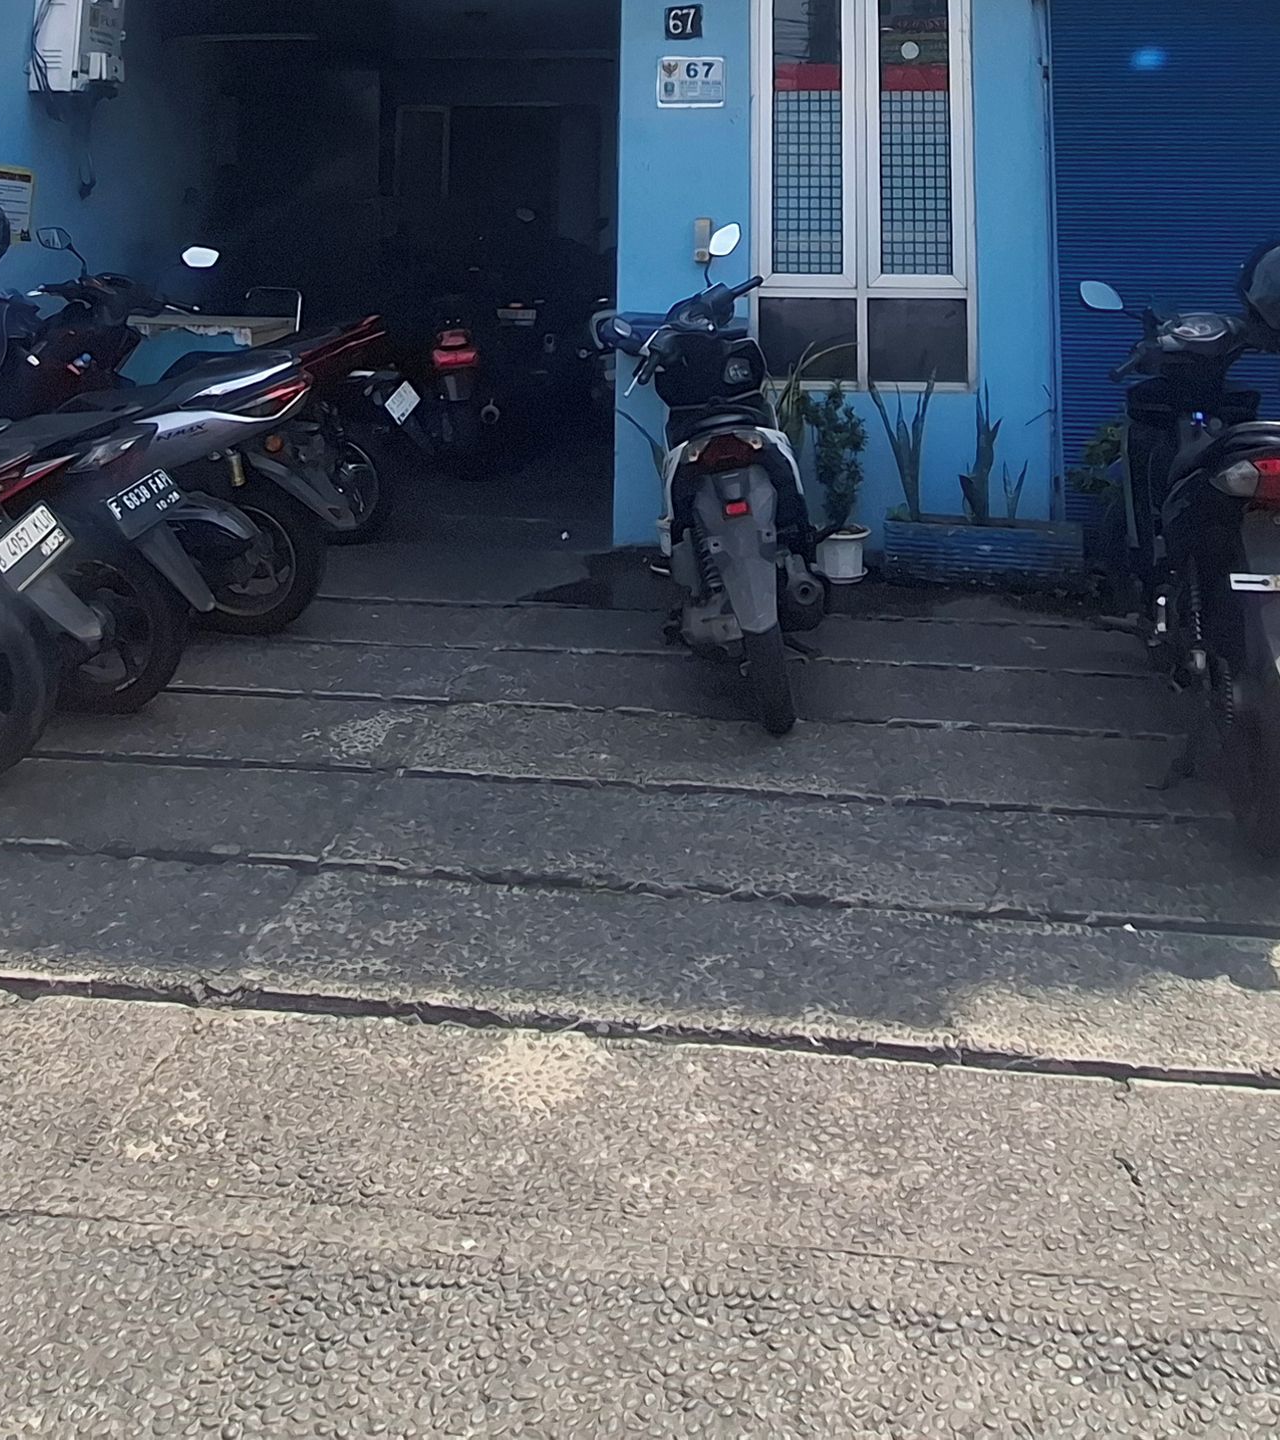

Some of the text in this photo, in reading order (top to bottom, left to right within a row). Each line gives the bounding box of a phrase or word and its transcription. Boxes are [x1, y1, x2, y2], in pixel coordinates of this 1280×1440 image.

[668, 8, 697, 34] 67
[685, 62, 716, 79] 67
[110, 502, 122, 521] F
[6, 526, 33, 557] 4957
